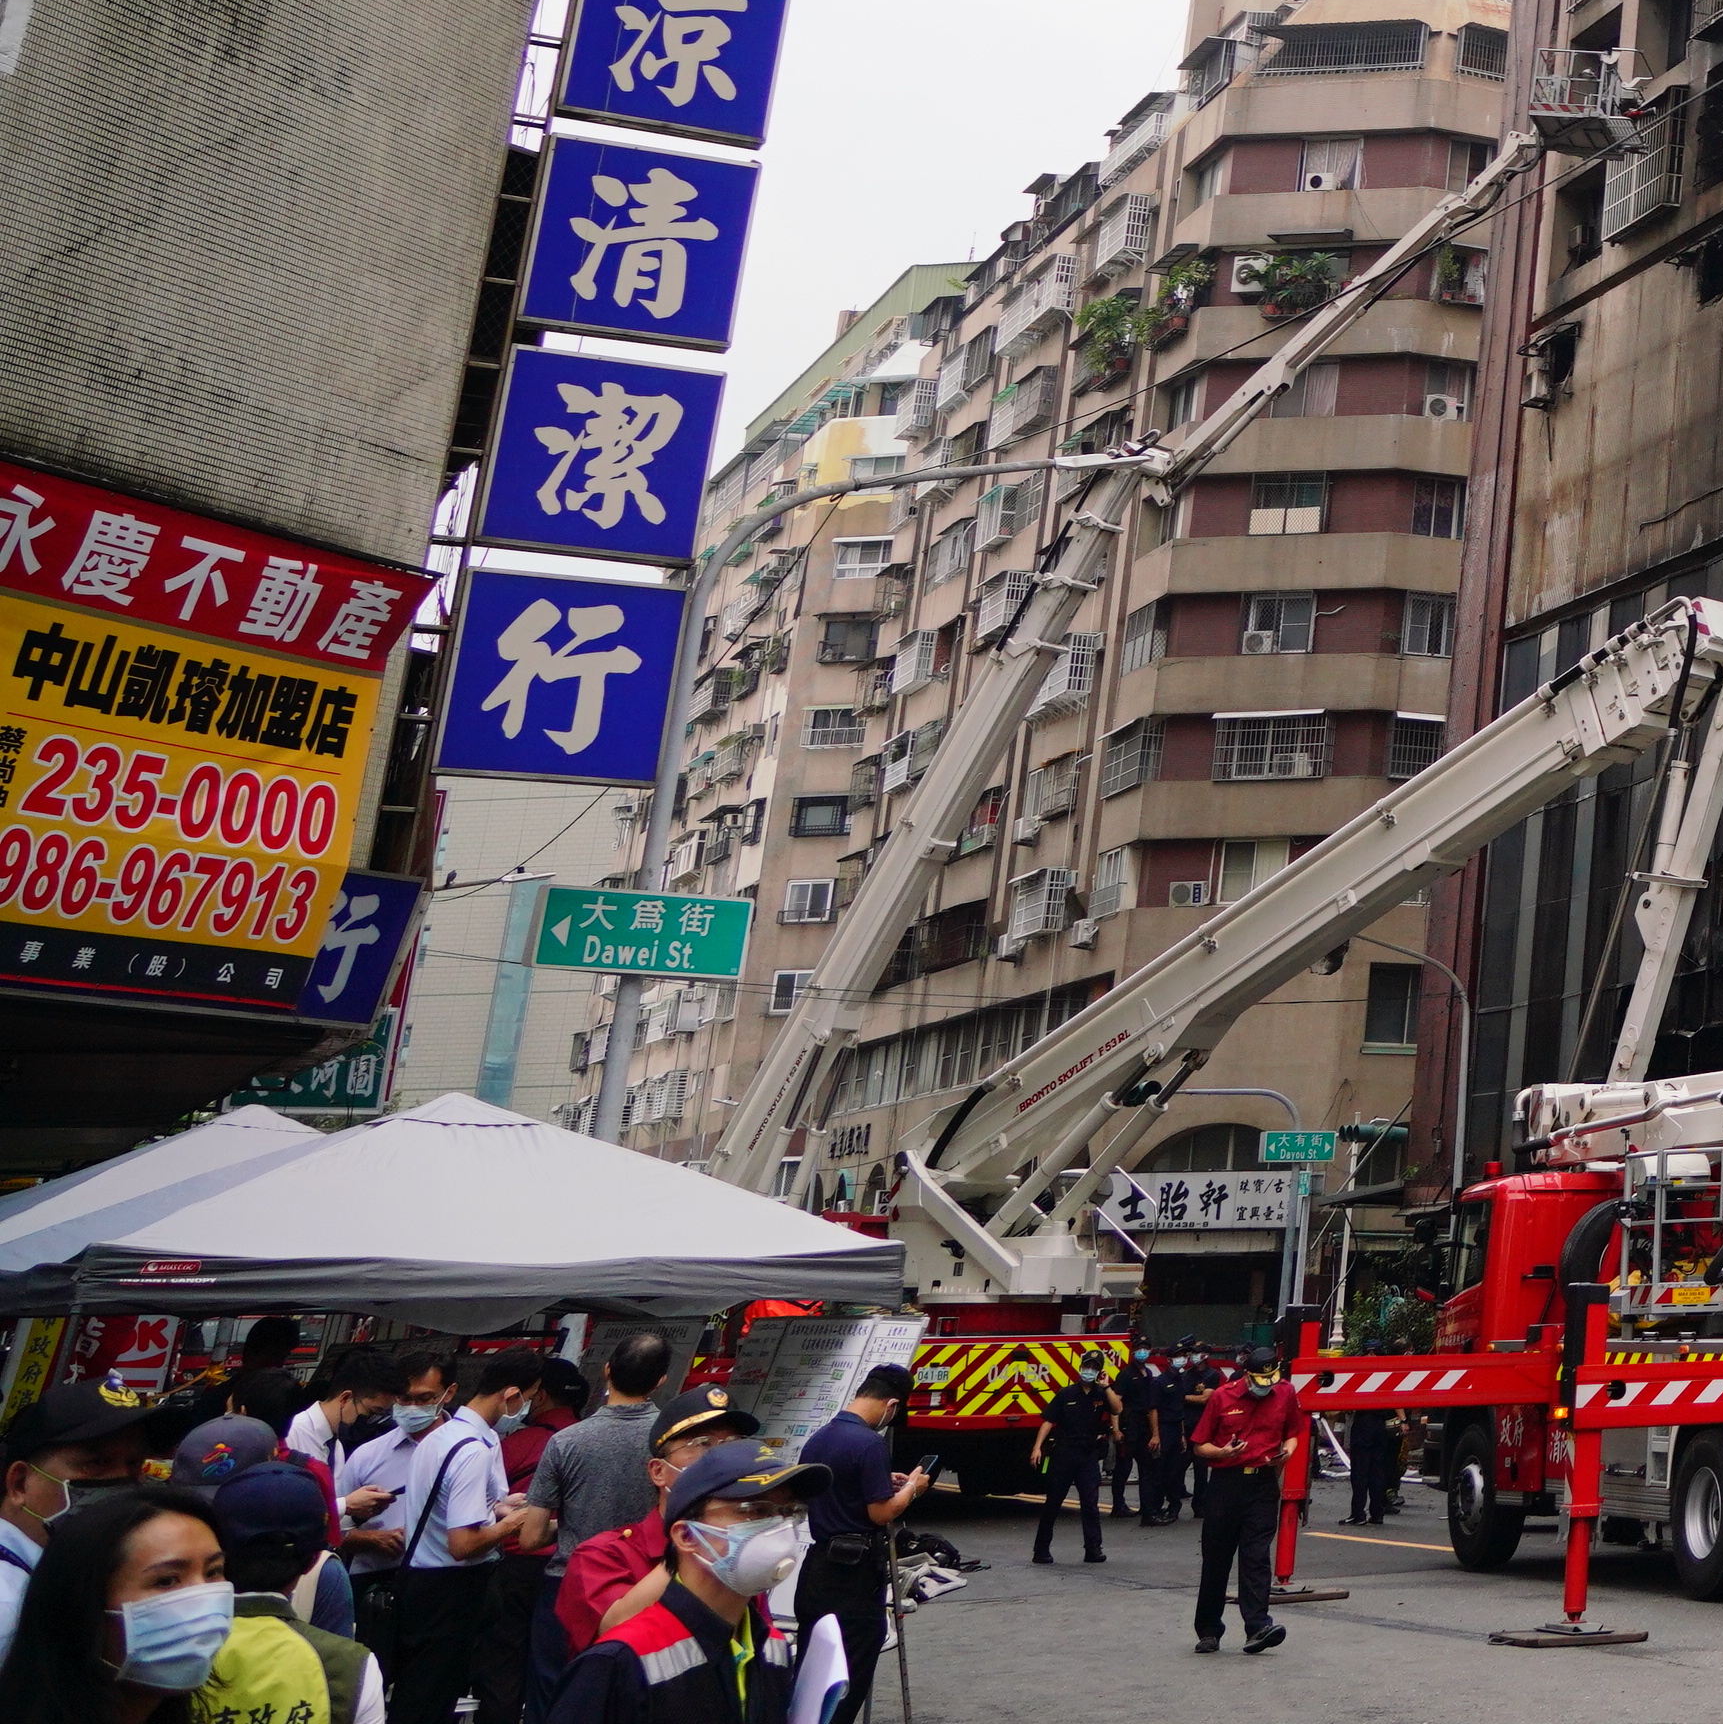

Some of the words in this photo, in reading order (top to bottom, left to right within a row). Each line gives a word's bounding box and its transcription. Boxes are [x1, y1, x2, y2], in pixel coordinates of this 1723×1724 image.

[0, 484, 403, 661] 永慶不動產
[17, 734, 338, 859] 235-0000
[583, 935, 659, 968] Dawei
[665, 941, 695, 970] St.
[1019, 1081, 1057, 1113] BRONTO
[1057, 1053, 1094, 1086] SKYLIFT
[1097, 1045, 1105, 1057] F
[1105, 1037, 1117, 1052] 53
[748, 1118, 769, 1152] BRONTO
[1278, 1134, 1323, 1147] 大有街
[1279, 1148, 1306, 1160] Dayou
